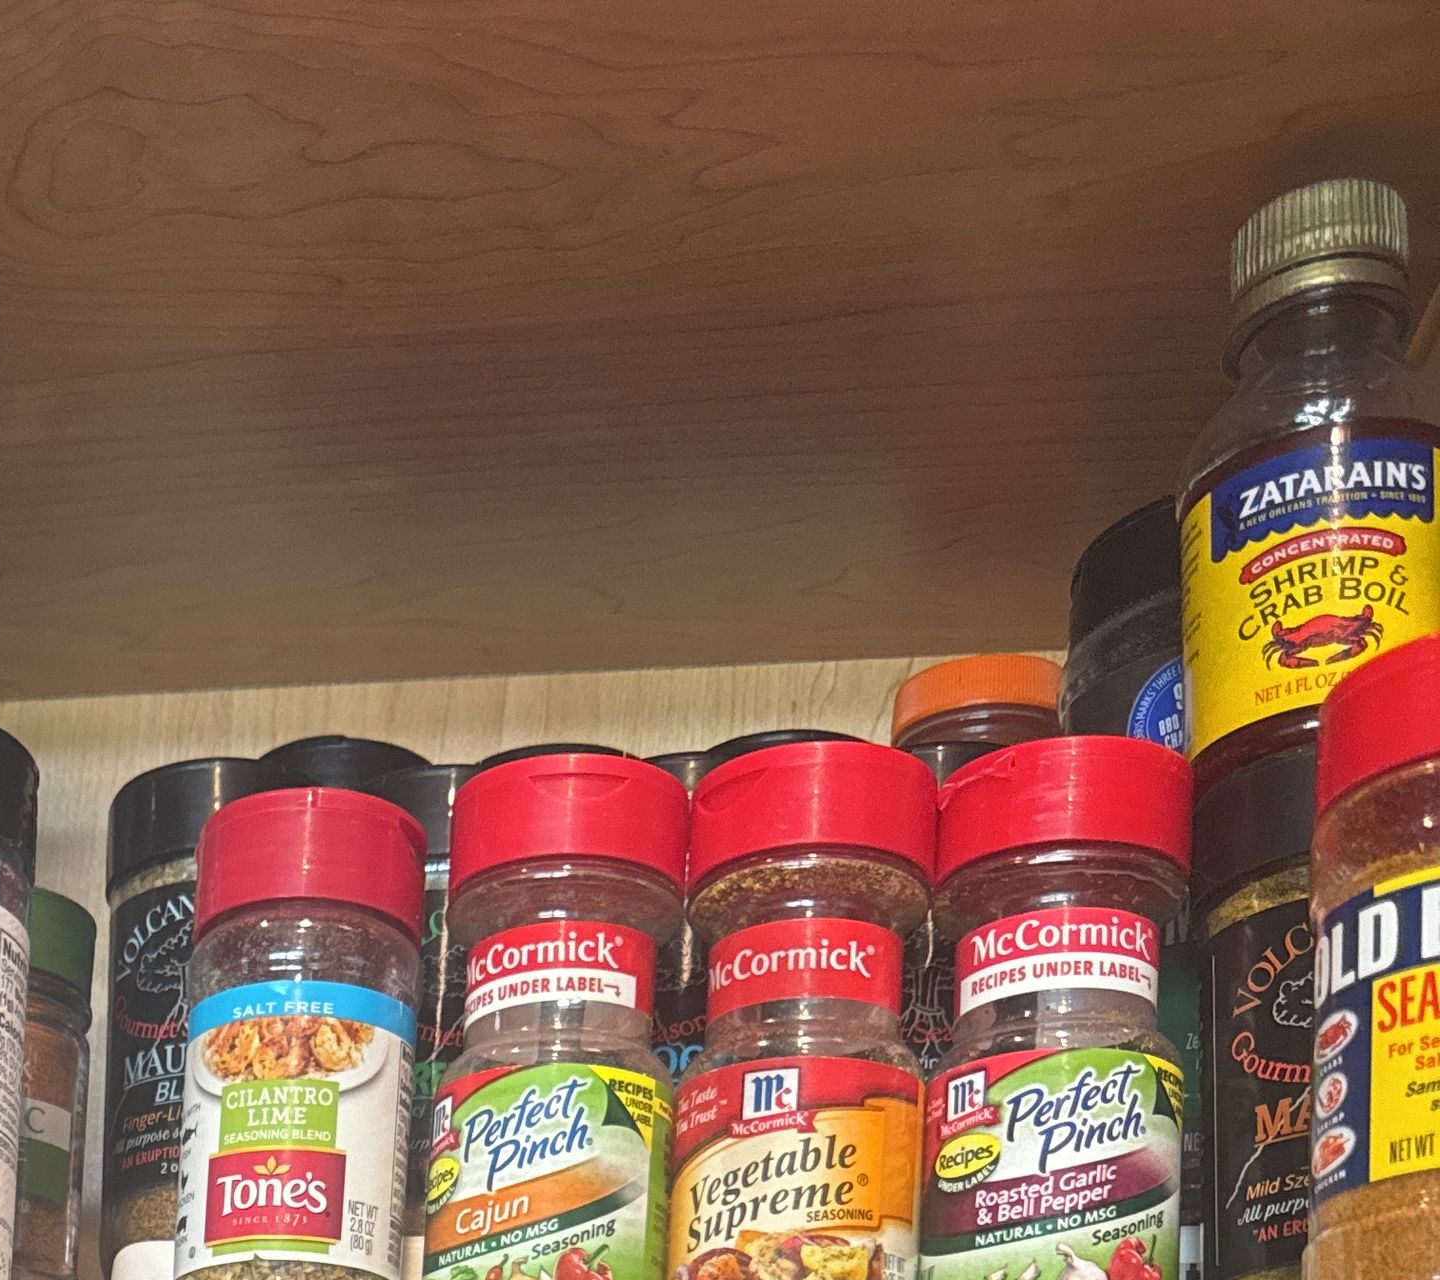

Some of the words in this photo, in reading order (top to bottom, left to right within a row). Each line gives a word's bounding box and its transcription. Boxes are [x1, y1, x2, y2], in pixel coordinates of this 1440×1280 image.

[1239, 460, 1428, 520] ZATARAIN'S
[1250, 534, 1394, 576] CONCENTRATED
[1249, 556, 1379, 608] SHRIMP
[1390, 564, 1409, 586] &
[1238, 584, 1324, 641] CRAB
[1338, 577, 1409, 616] BOIL
[1254, 682, 1282, 706] NET
[1284, 680, 1292, 696] 4
[1296, 675, 1312, 693] FL
[1315, 671, 1337, 689] OZ
[970, 916, 1150, 968] McCormick
[970, 965, 1026, 997] RECIPES
[1032, 961, 1092, 979] UNDER
[1099, 964, 1140, 984] LABEL
[232, 1001, 279, 1019] SALT
[284, 1001, 335, 1015] FREE
[226, 1087, 334, 1111] CILANTRO
[247, 1107, 307, 1127] LIME
[464, 1076, 588, 1163] Perfect
[1006, 1064, 1145, 1143] Perfect
[223, 1127, 289, 1145] SEASONING
[292, 1129, 331, 1144] BLEND
[486, 1106, 589, 1192] Pinch
[1037, 1103, 1142, 1174] Pinch
[1389, 1135, 1412, 1164] NET
[1414, 1134, 1434, 1159] WT
[689, 1135, 857, 1215] Vegetable
[938, 1143, 993, 1174] Recipes
[975, 1176, 1053, 1208] Roasted
[1059, 1162, 1117, 1192] Garlic
[976, 1208, 992, 1226] &
[998, 1194, 1034, 1223] Bell
[1039, 1184, 1111, 1216] Pepper
[232, 1214, 269, 1227] SINCE
[275, 1211, 308, 1228] 1873
[455, 1191, 529, 1236] Cajun
[687, 1177, 855, 1255] Supreme
[806, 1209, 873, 1224] SEASONING
[975, 1224, 1042, 1248] NATURAL
[1057, 1214, 1080, 1231] NO
[1084, 1206, 1117, 1224] MSG
[1091, 1209, 1164, 1247] Seasoning
[532, 1218, 616, 1261] Seasoning
